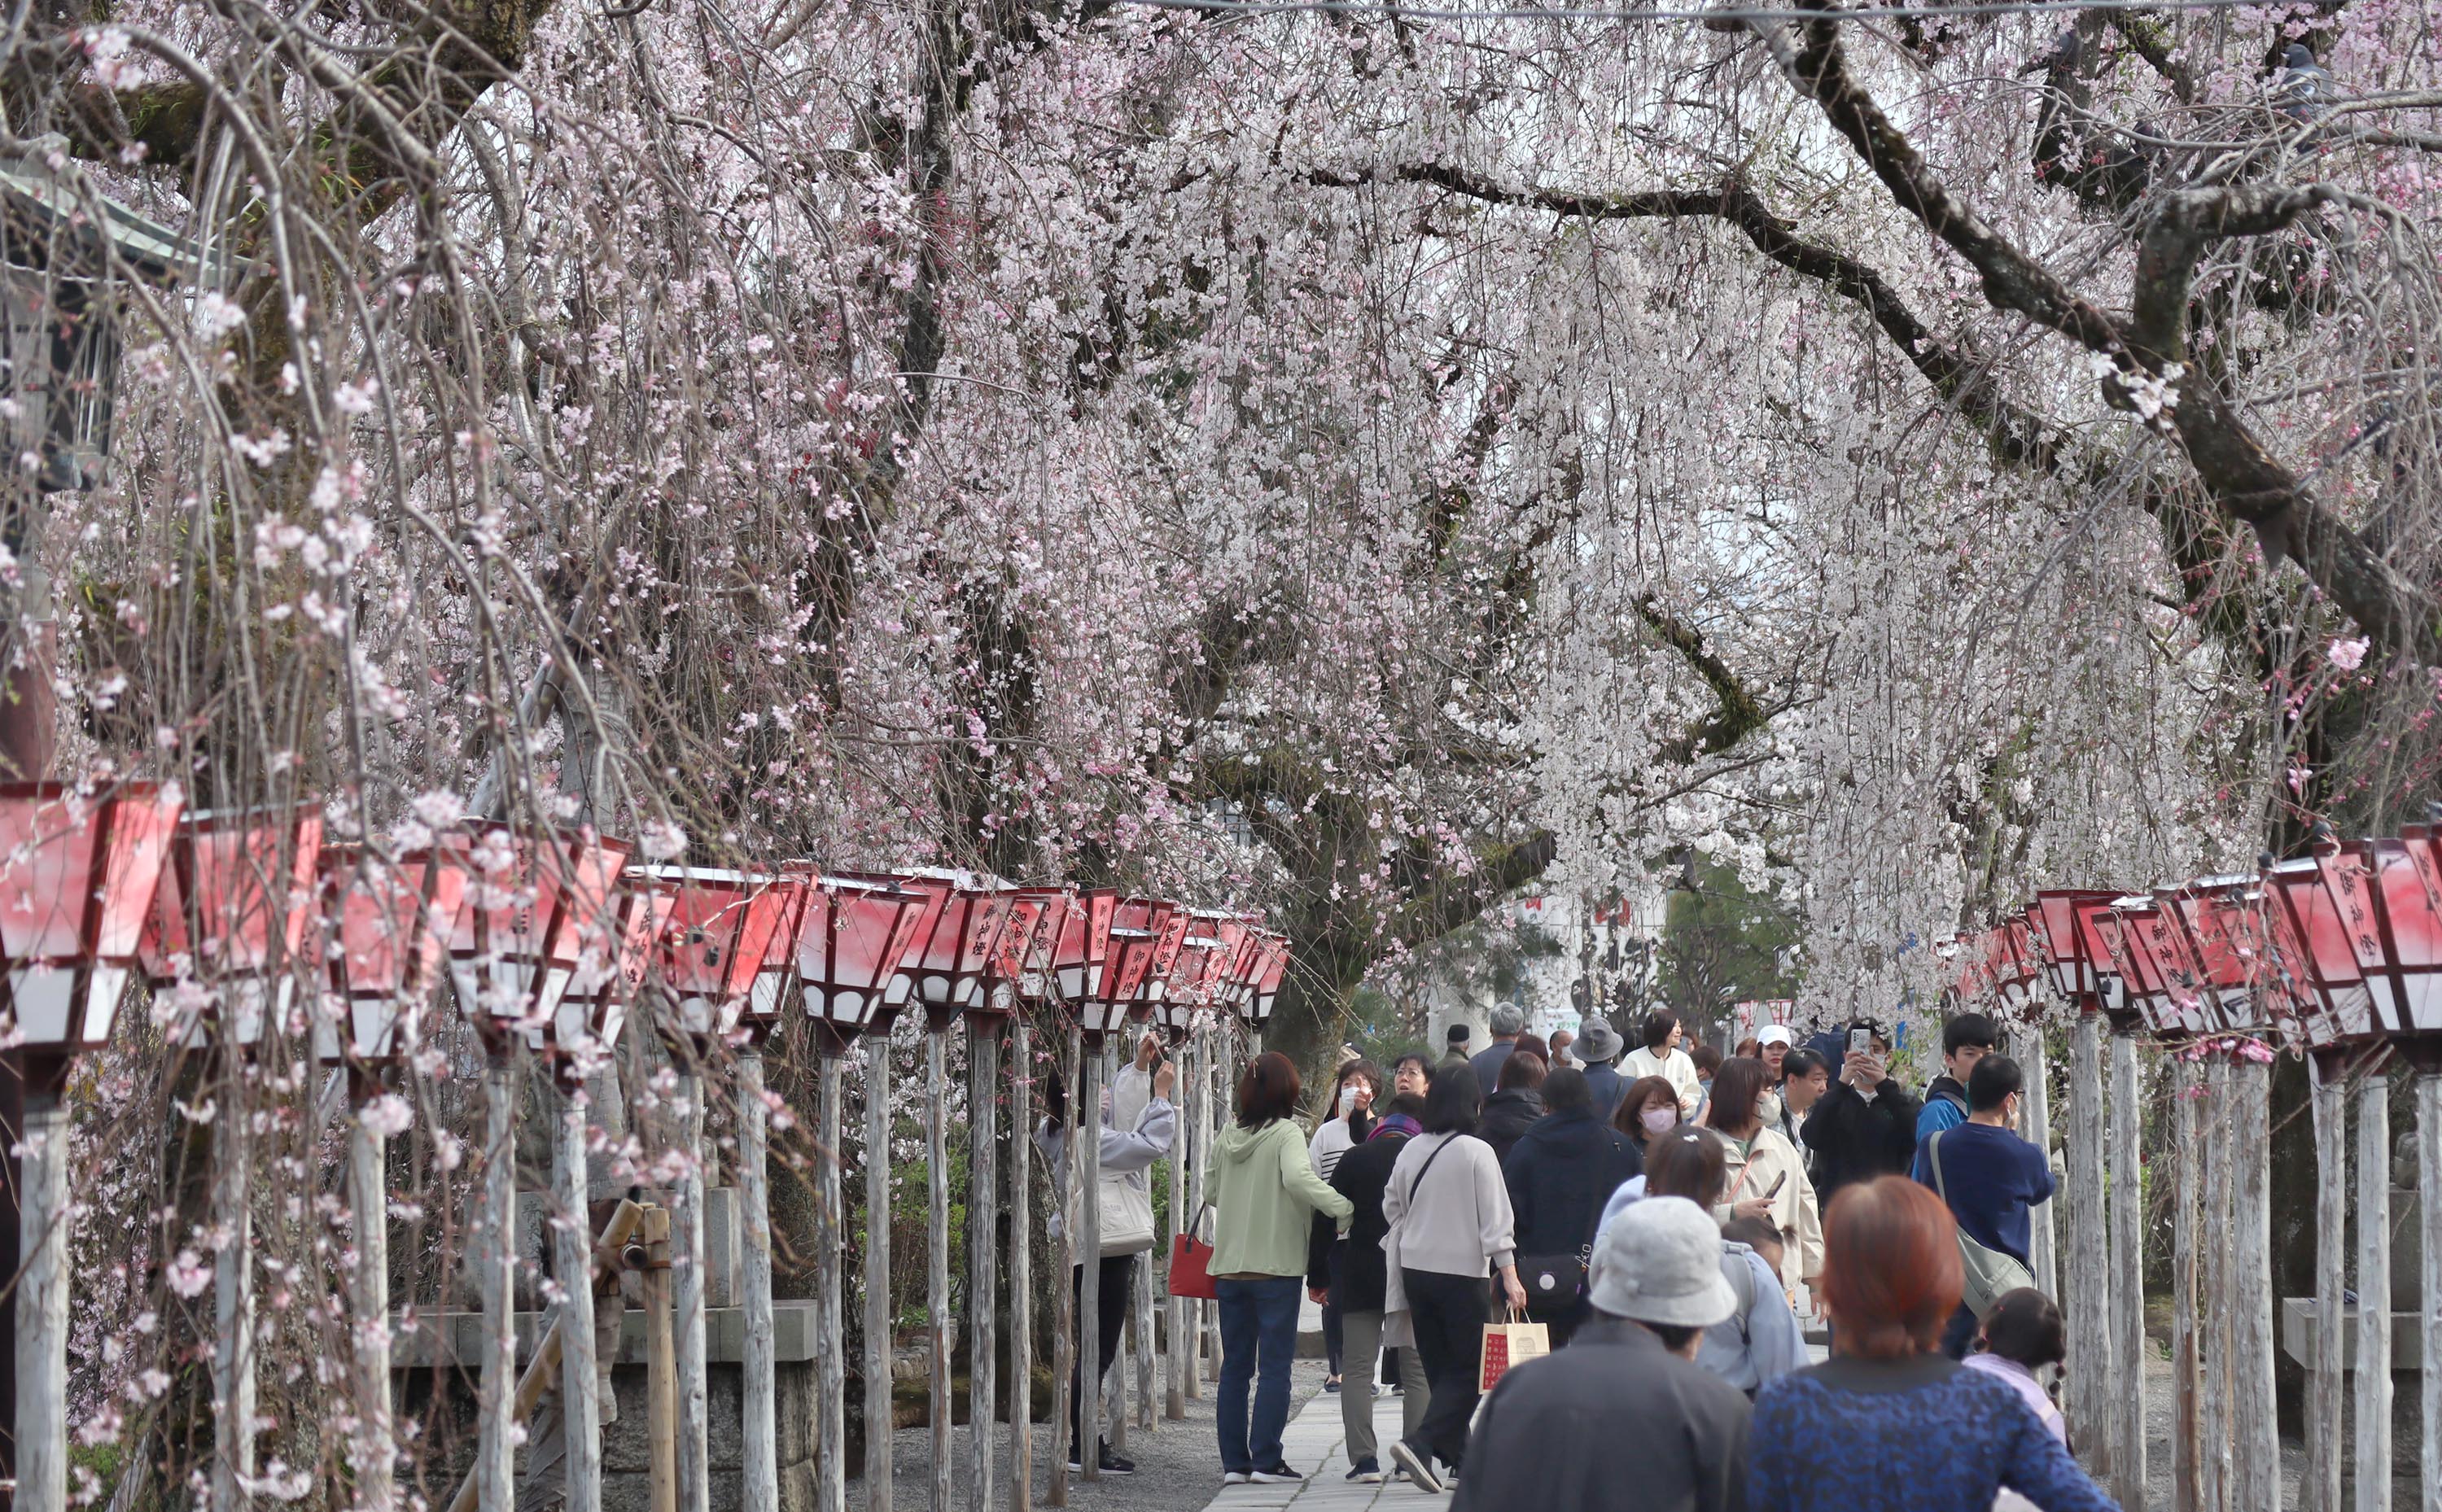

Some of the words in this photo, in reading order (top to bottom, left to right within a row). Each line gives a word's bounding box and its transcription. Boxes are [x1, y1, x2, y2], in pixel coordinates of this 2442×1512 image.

[1096, 903, 1108, 950] 御神燈
[2339, 871, 2377, 956] 御神燈
[1122, 948, 1146, 994] 御神燈
